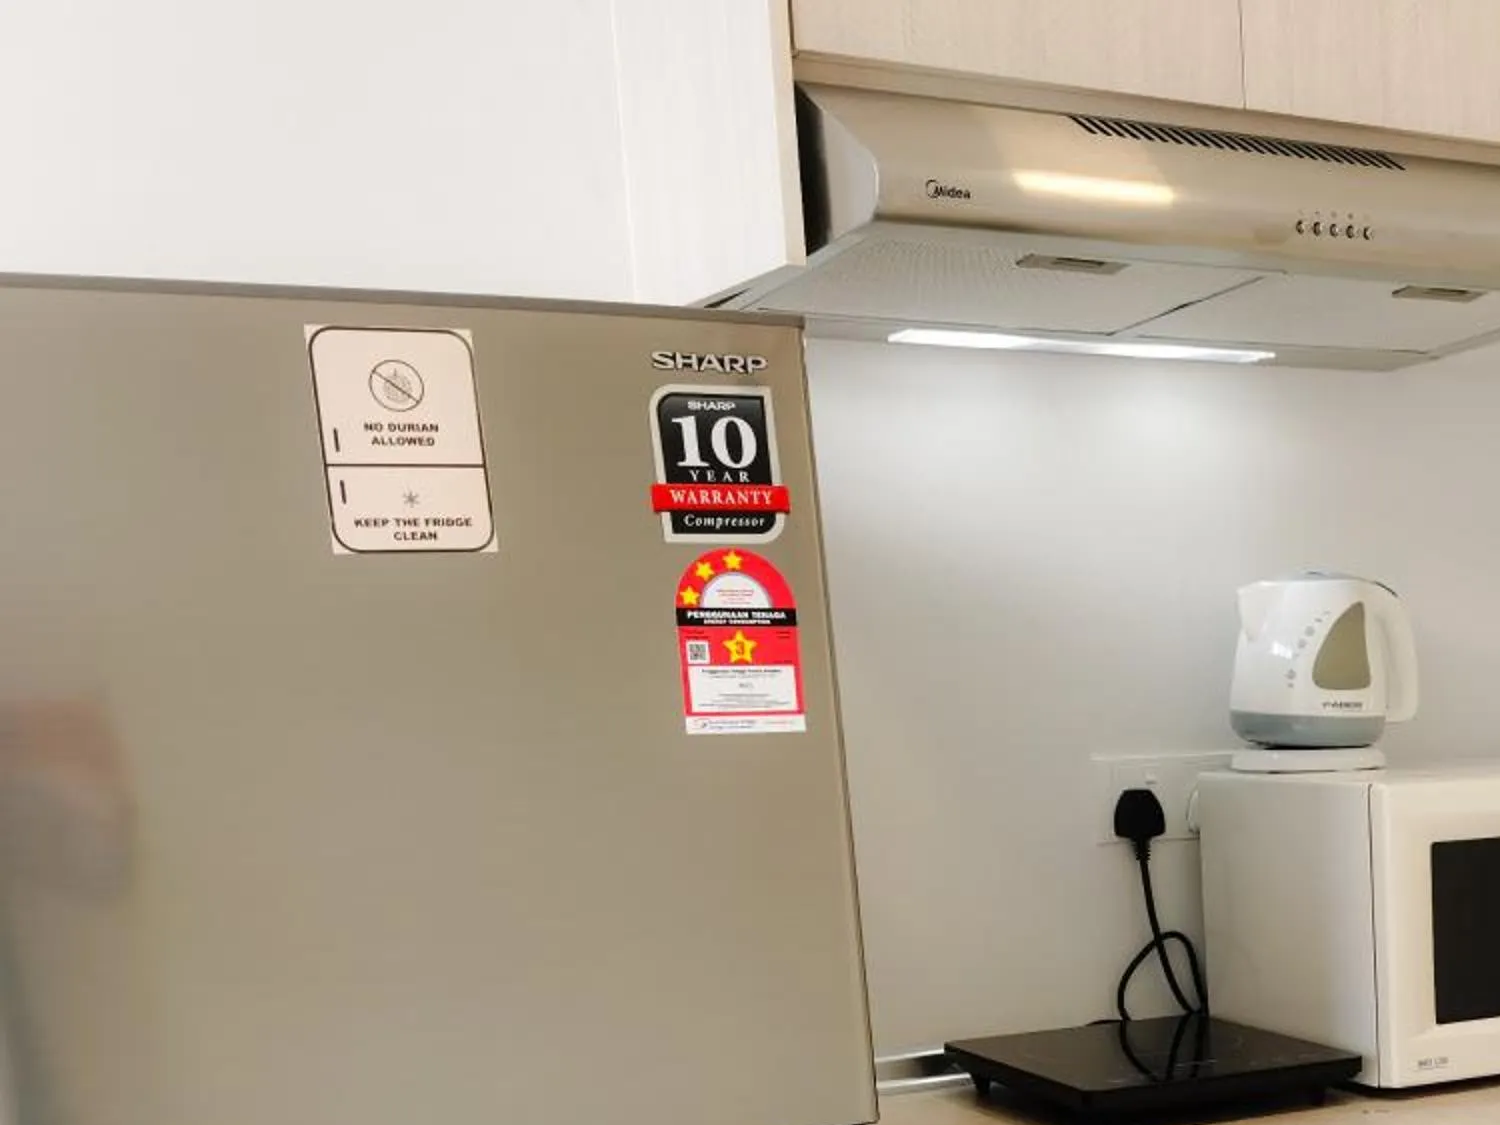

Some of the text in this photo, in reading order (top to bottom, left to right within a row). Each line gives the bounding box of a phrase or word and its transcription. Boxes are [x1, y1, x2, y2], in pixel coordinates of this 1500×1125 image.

[652, 351, 768, 373] SHARP
[687, 400, 736, 411] SHARP
[363, 422, 439, 433] NO DURIAN
[371, 436, 435, 447] ALLOWED
[671, 415, 758, 469] 10
[688, 470, 750, 483] YEAR
[669, 489, 773, 505] WARRANTY
[353, 518, 473, 528] KEEP THE FRIDGE
[683, 514, 766, 530] Compressor
[393, 531, 438, 541] CLEAN
